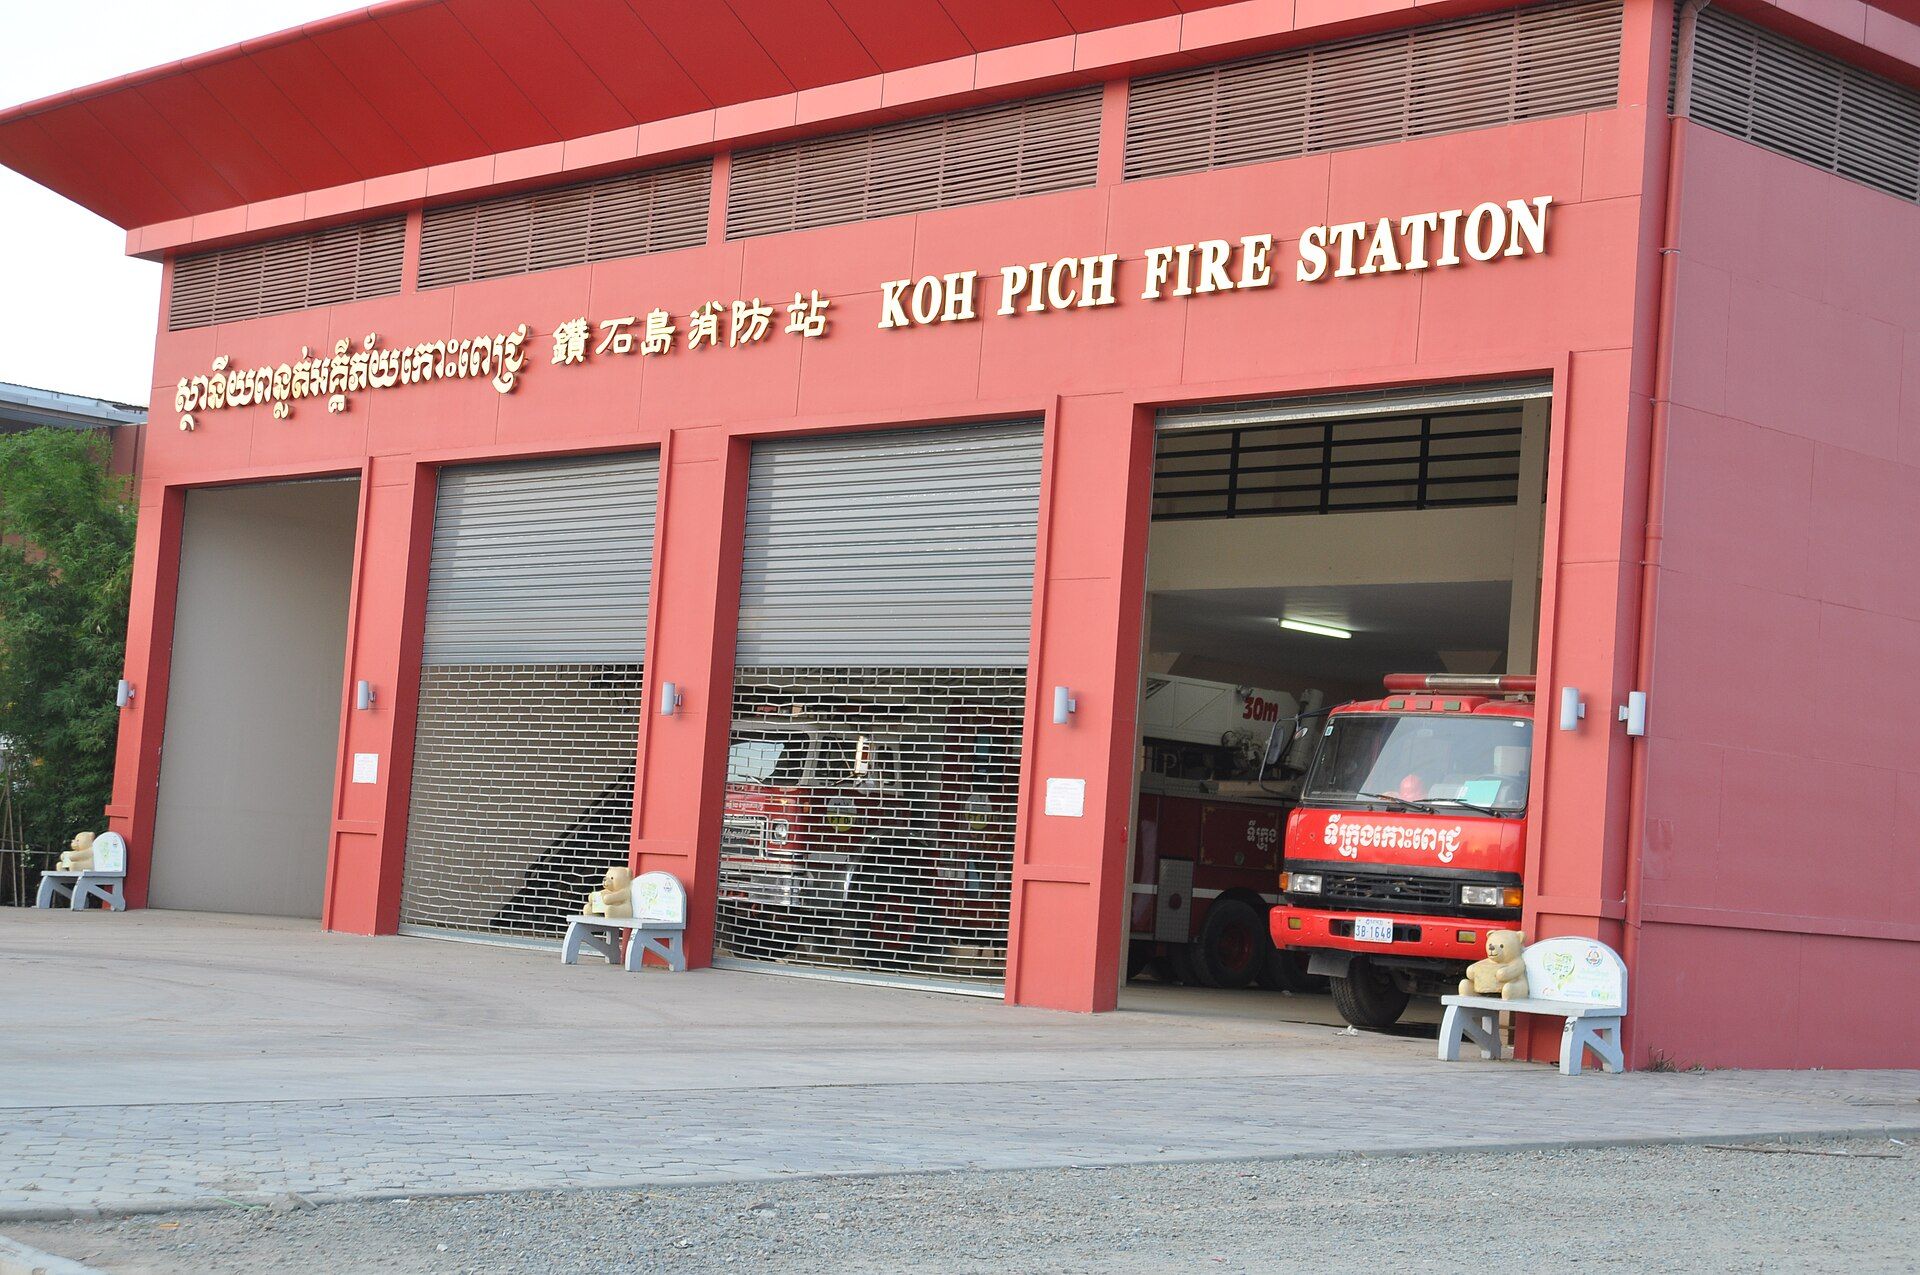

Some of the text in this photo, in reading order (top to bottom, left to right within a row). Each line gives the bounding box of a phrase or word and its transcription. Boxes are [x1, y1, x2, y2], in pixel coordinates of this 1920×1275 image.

[877, 195, 1553, 329] KOH PICH FIRE STATION
[551, 289, 830, 365] 鑽石島消防站
[1242, 696, 1279, 722] 30m
